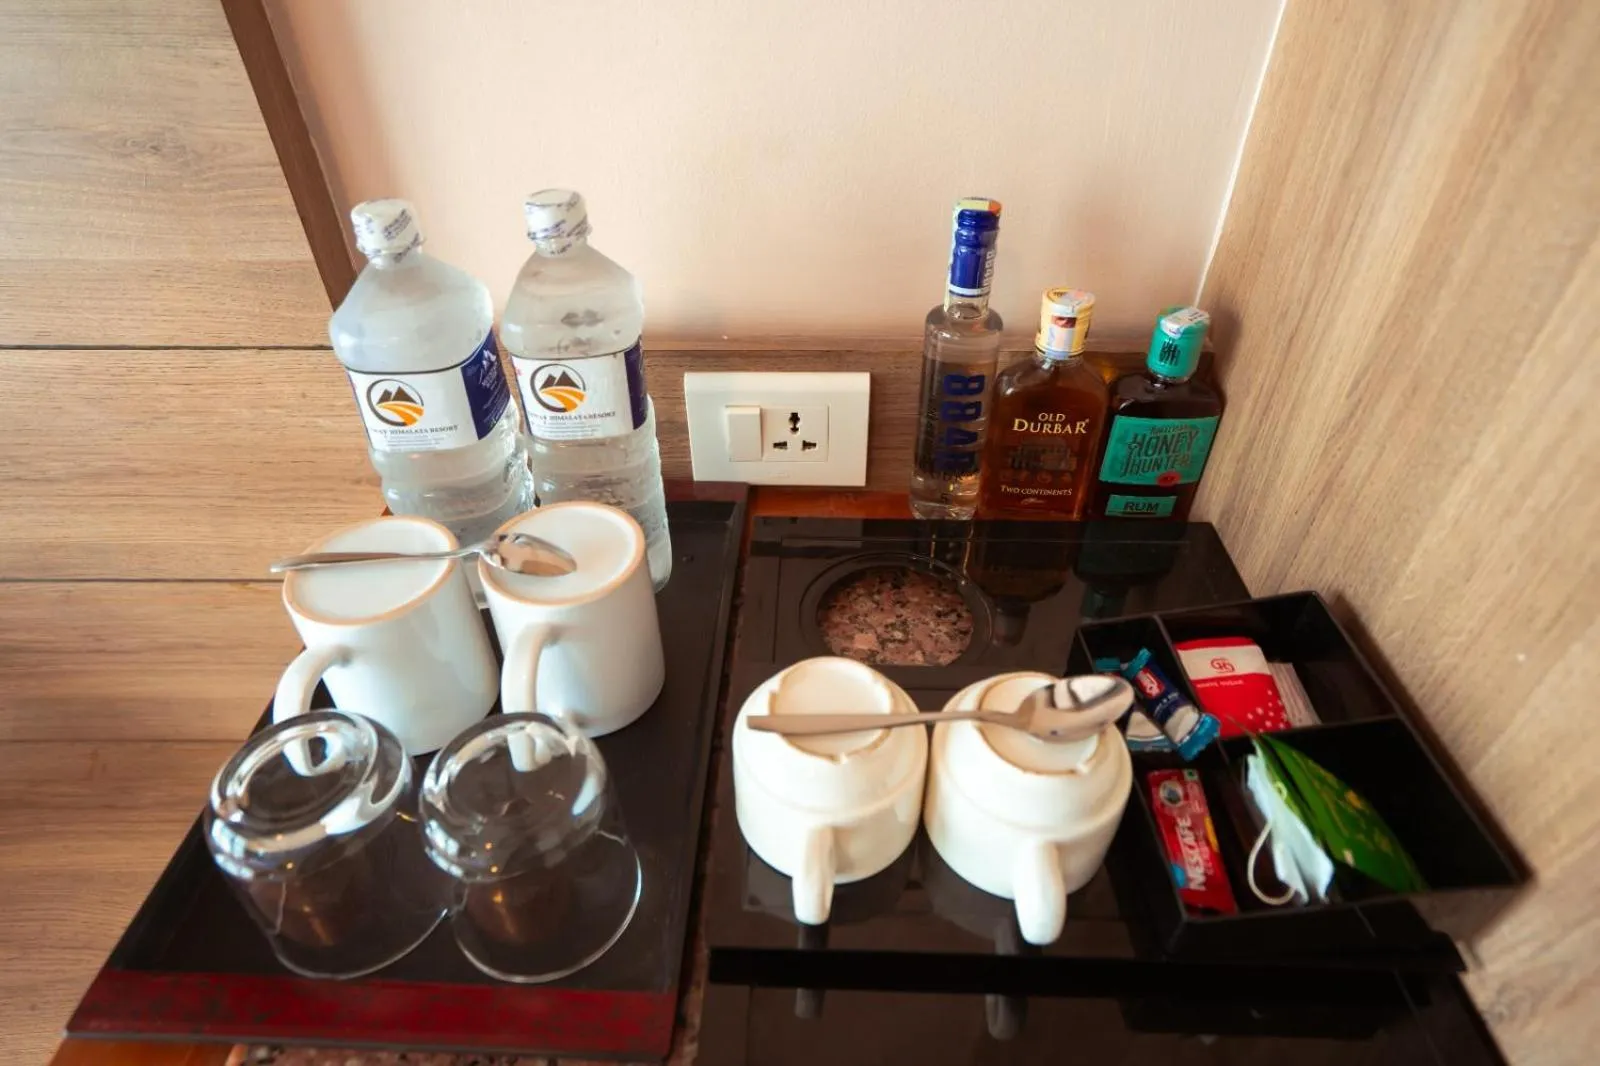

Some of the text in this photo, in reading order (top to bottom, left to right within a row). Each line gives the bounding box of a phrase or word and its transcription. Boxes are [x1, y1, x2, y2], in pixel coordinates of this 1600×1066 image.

[1038, 412, 1066, 422] OLD
[1012, 418, 1087, 434] DURBAR
[1128, 426, 1199, 459] HONEY
[1000, 484, 1073, 496] TWO CONTINENTS
[1124, 501, 1159, 513] RUM
